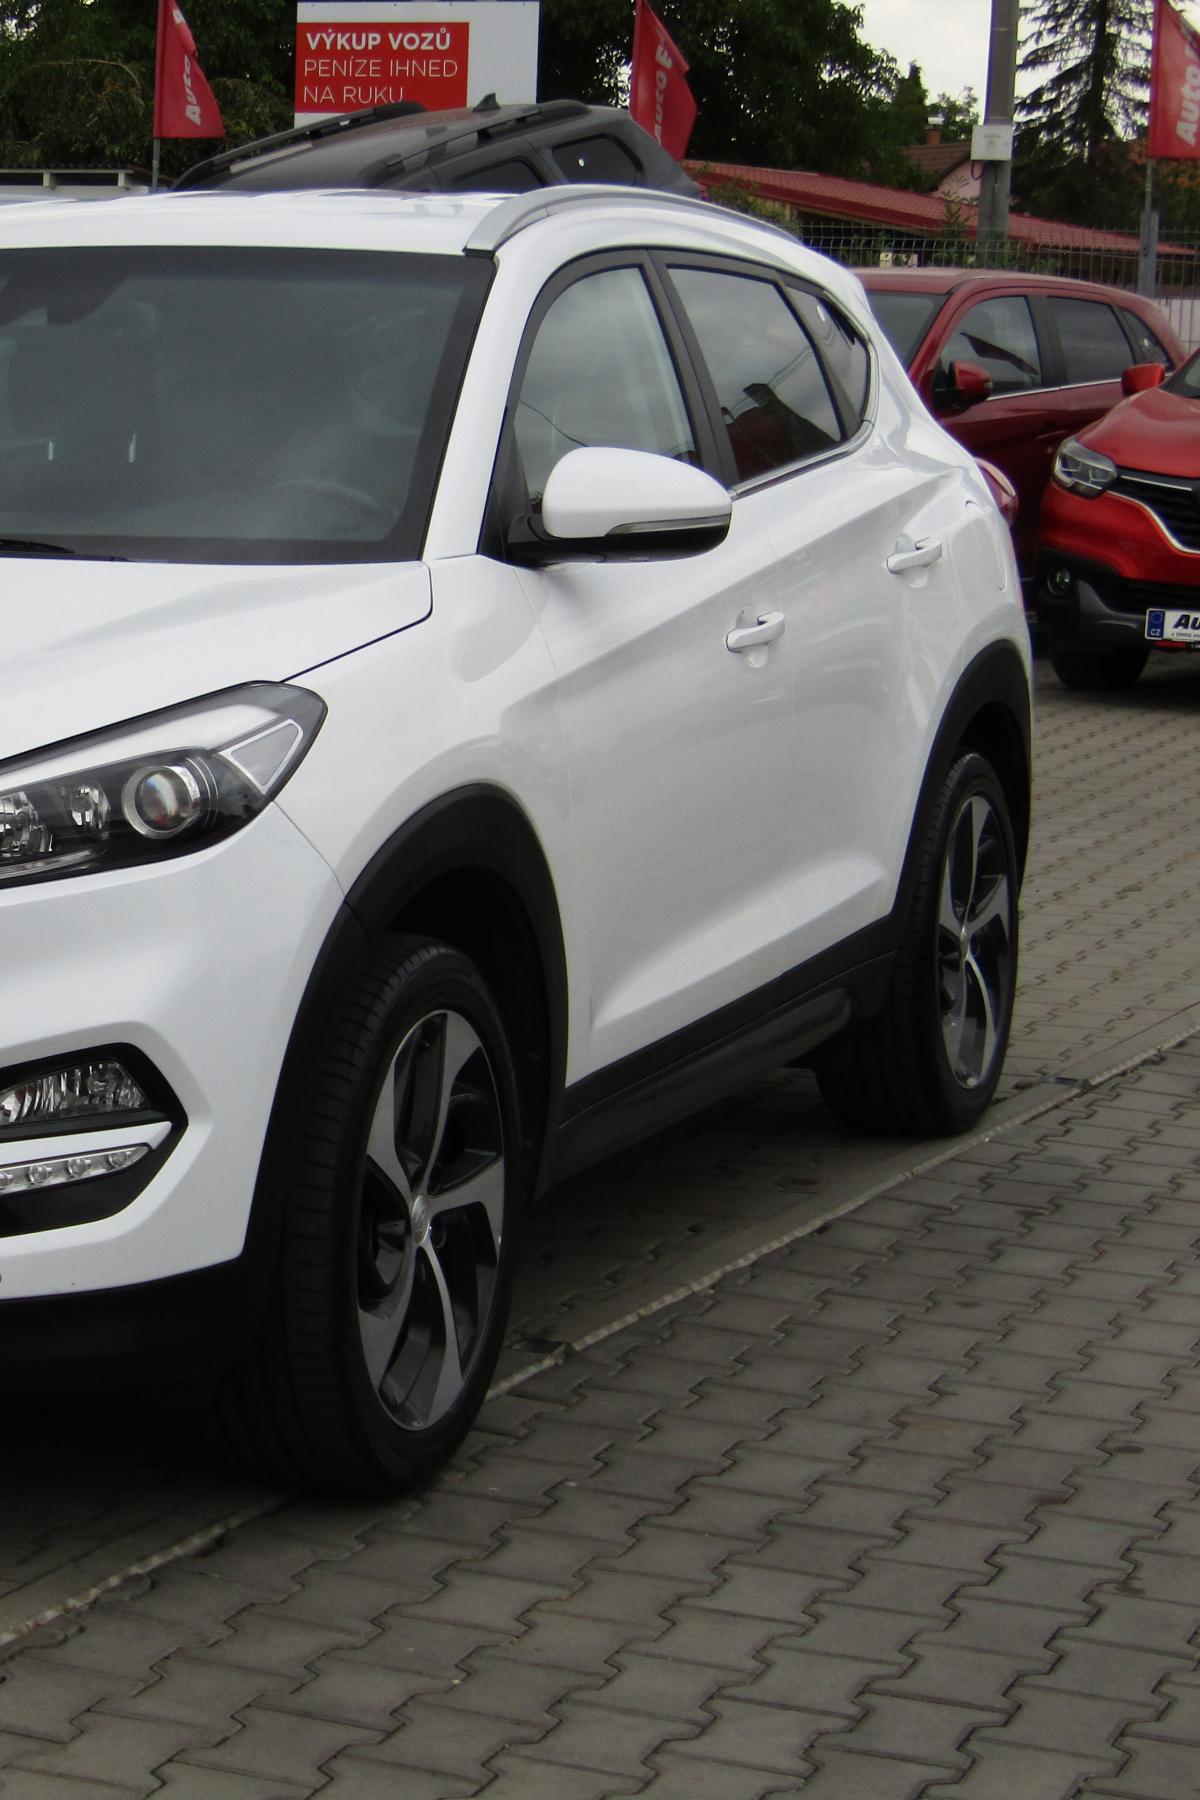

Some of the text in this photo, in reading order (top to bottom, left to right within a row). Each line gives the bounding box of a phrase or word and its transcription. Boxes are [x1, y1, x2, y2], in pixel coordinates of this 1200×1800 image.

[306, 27, 451, 50] VÝKUP VOZŮ
[304, 56, 458, 77] PENÍZE IHNED
[183, 54, 201, 127] Auto
[303, 87, 403, 104] NA RUKU
